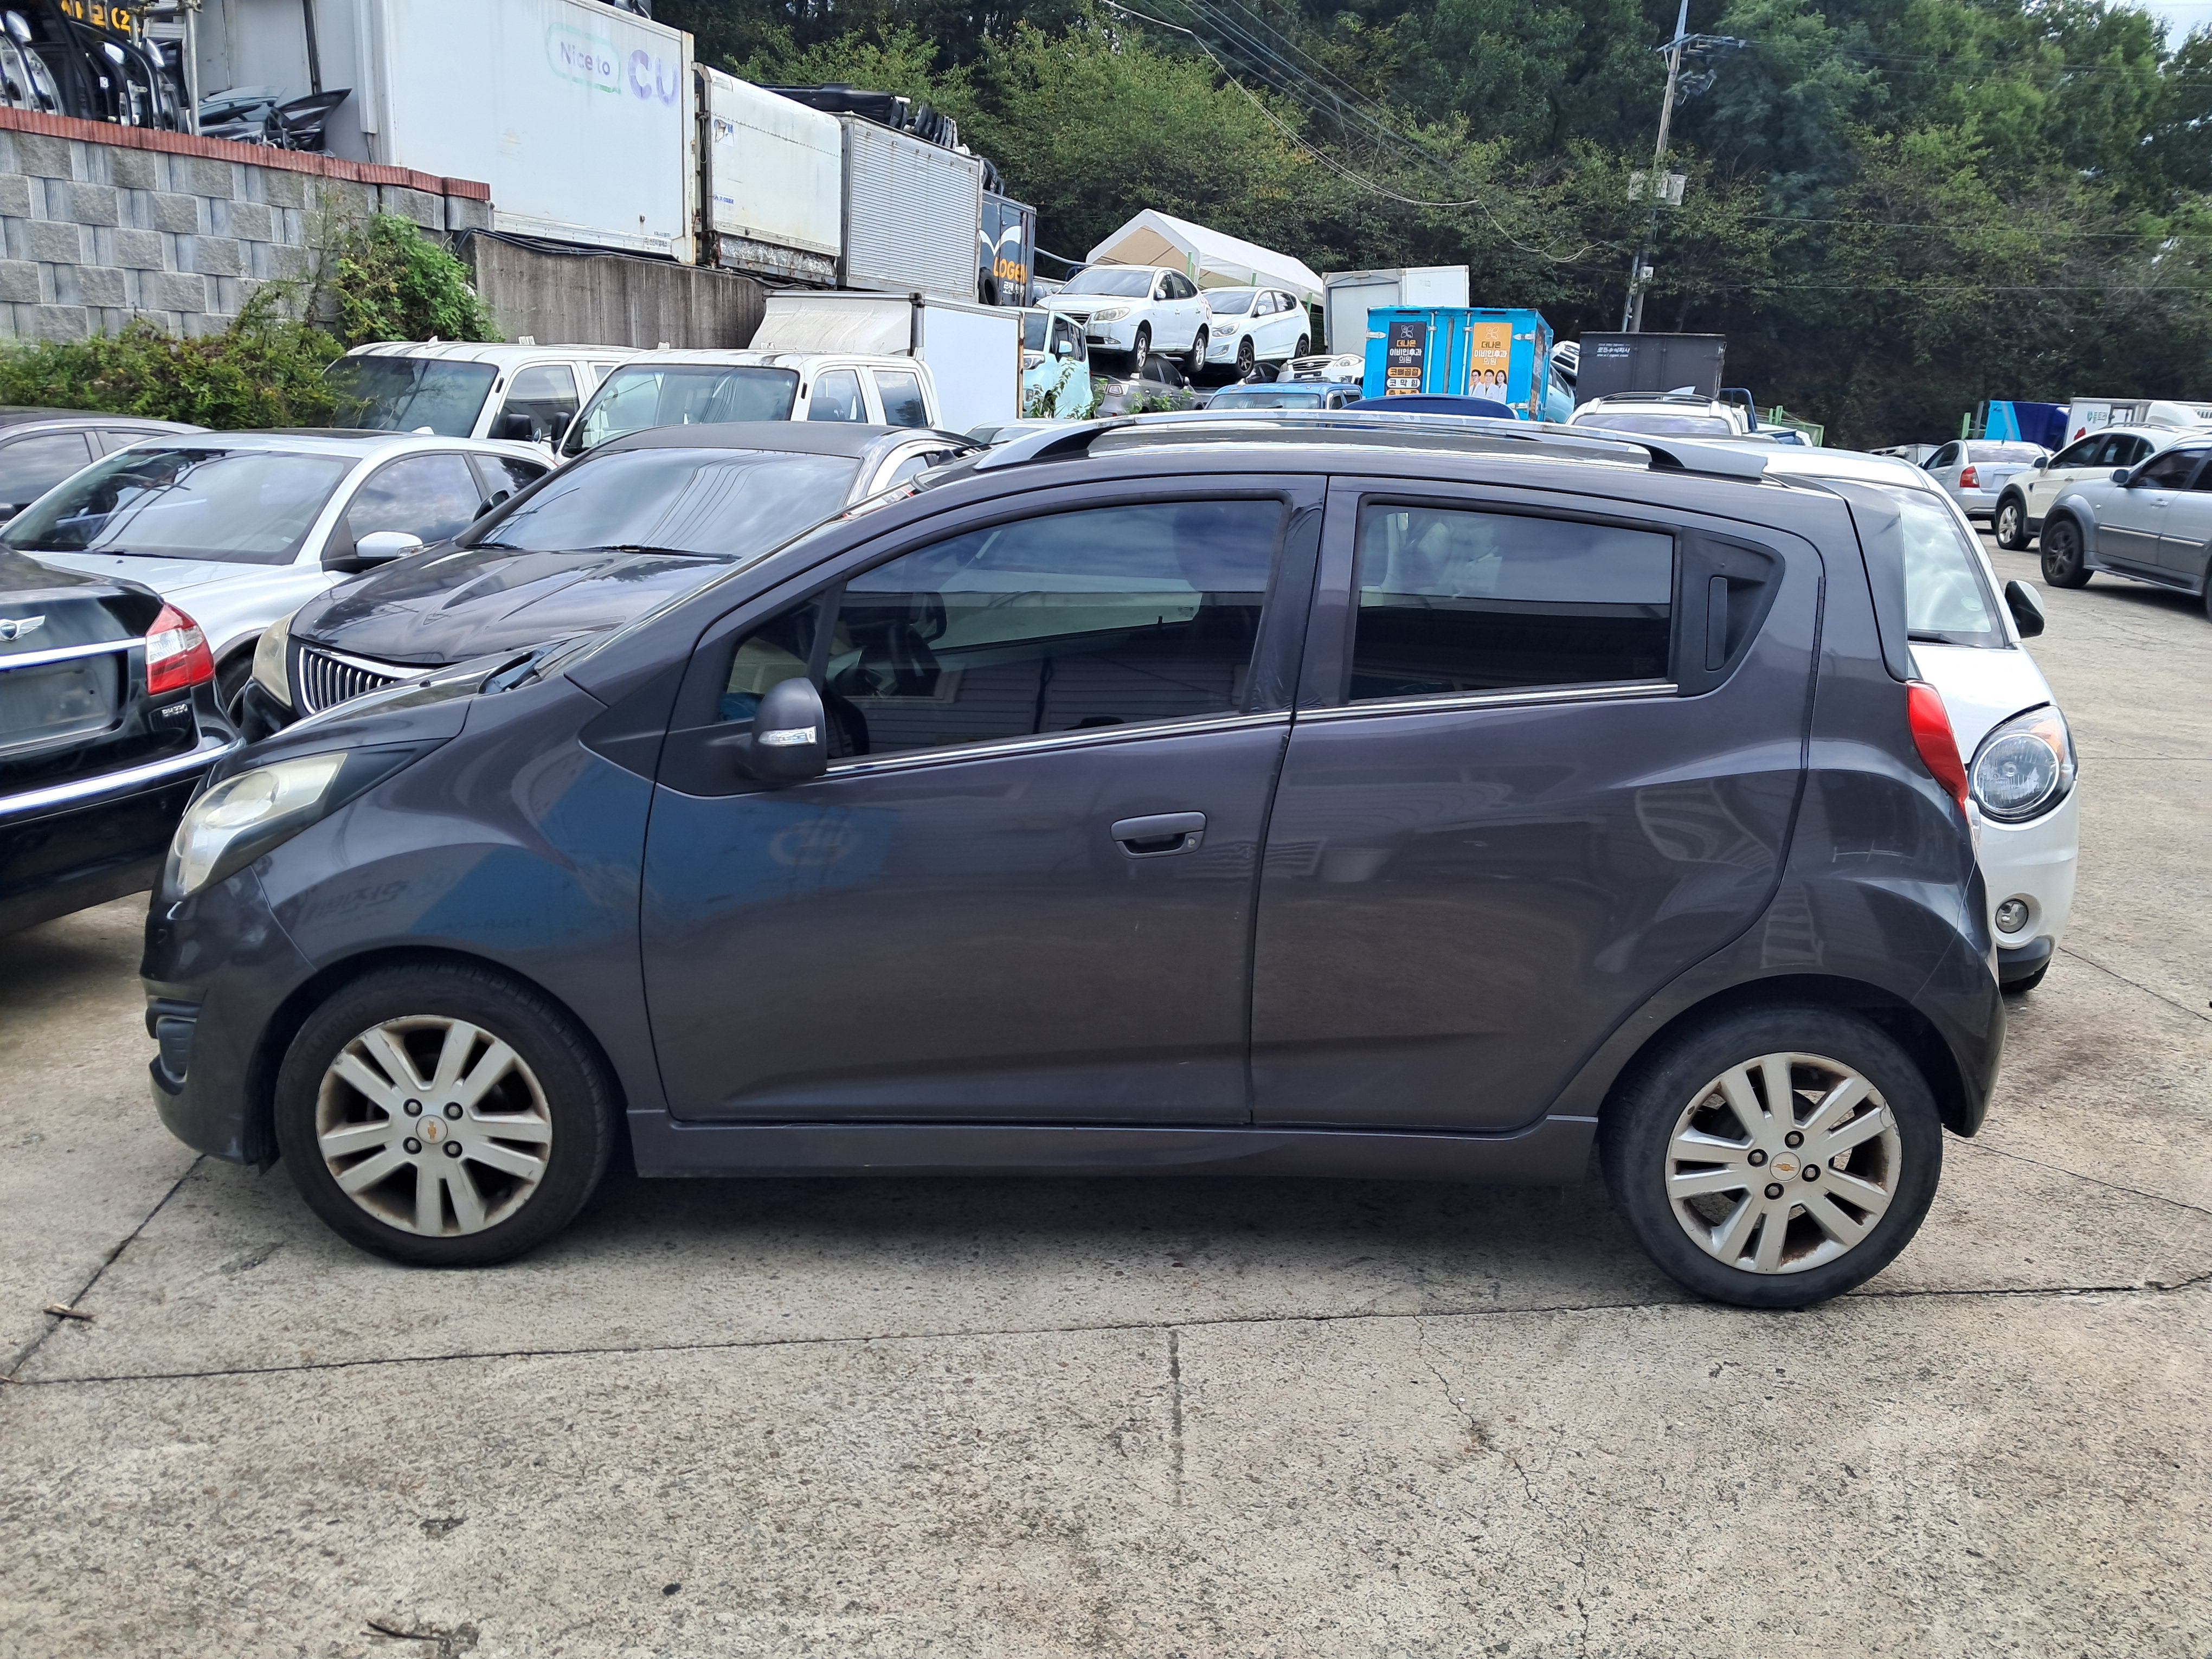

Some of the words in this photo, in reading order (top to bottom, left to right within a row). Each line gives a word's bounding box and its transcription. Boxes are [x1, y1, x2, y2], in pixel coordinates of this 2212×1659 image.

[560, 41, 593, 71] Nice
[596, 57, 611, 76] to
[628, 49, 680, 107] CU
[993, 256, 1027, 284] LOGEN
[1390, 348, 1422, 356] 이비인후과
[1474, 350, 1507, 358] 이비인후과
